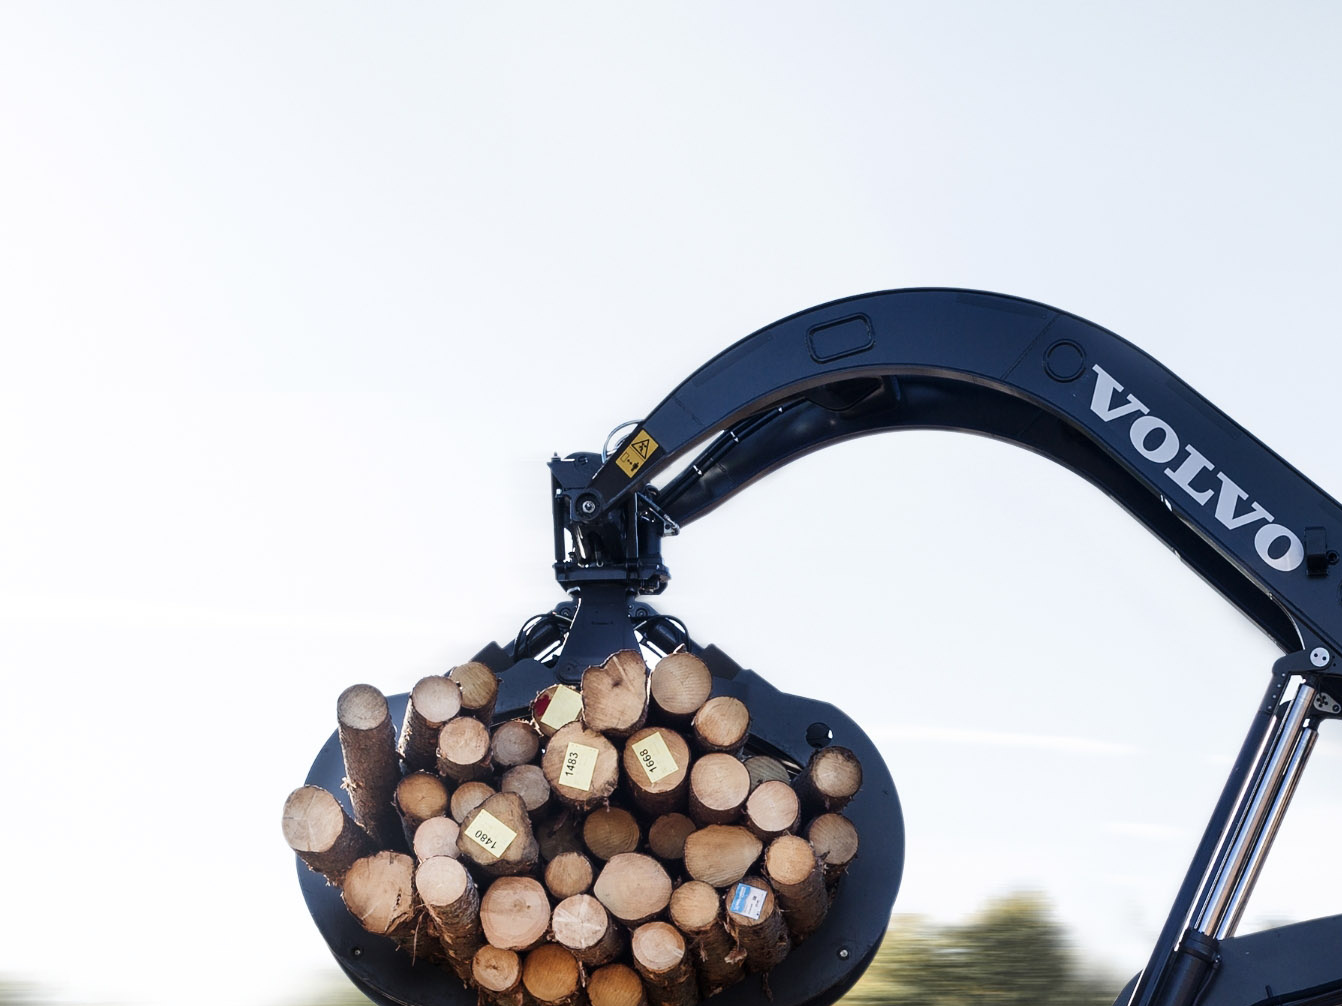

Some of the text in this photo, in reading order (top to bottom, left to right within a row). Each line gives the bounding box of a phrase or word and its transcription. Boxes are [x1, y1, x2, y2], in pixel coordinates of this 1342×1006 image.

[1090, 364, 1305, 572] VOLVO
[565, 752, 579, 777] 1483
[640, 748, 658, 774] 1668
[474, 830, 497, 849] 1480
